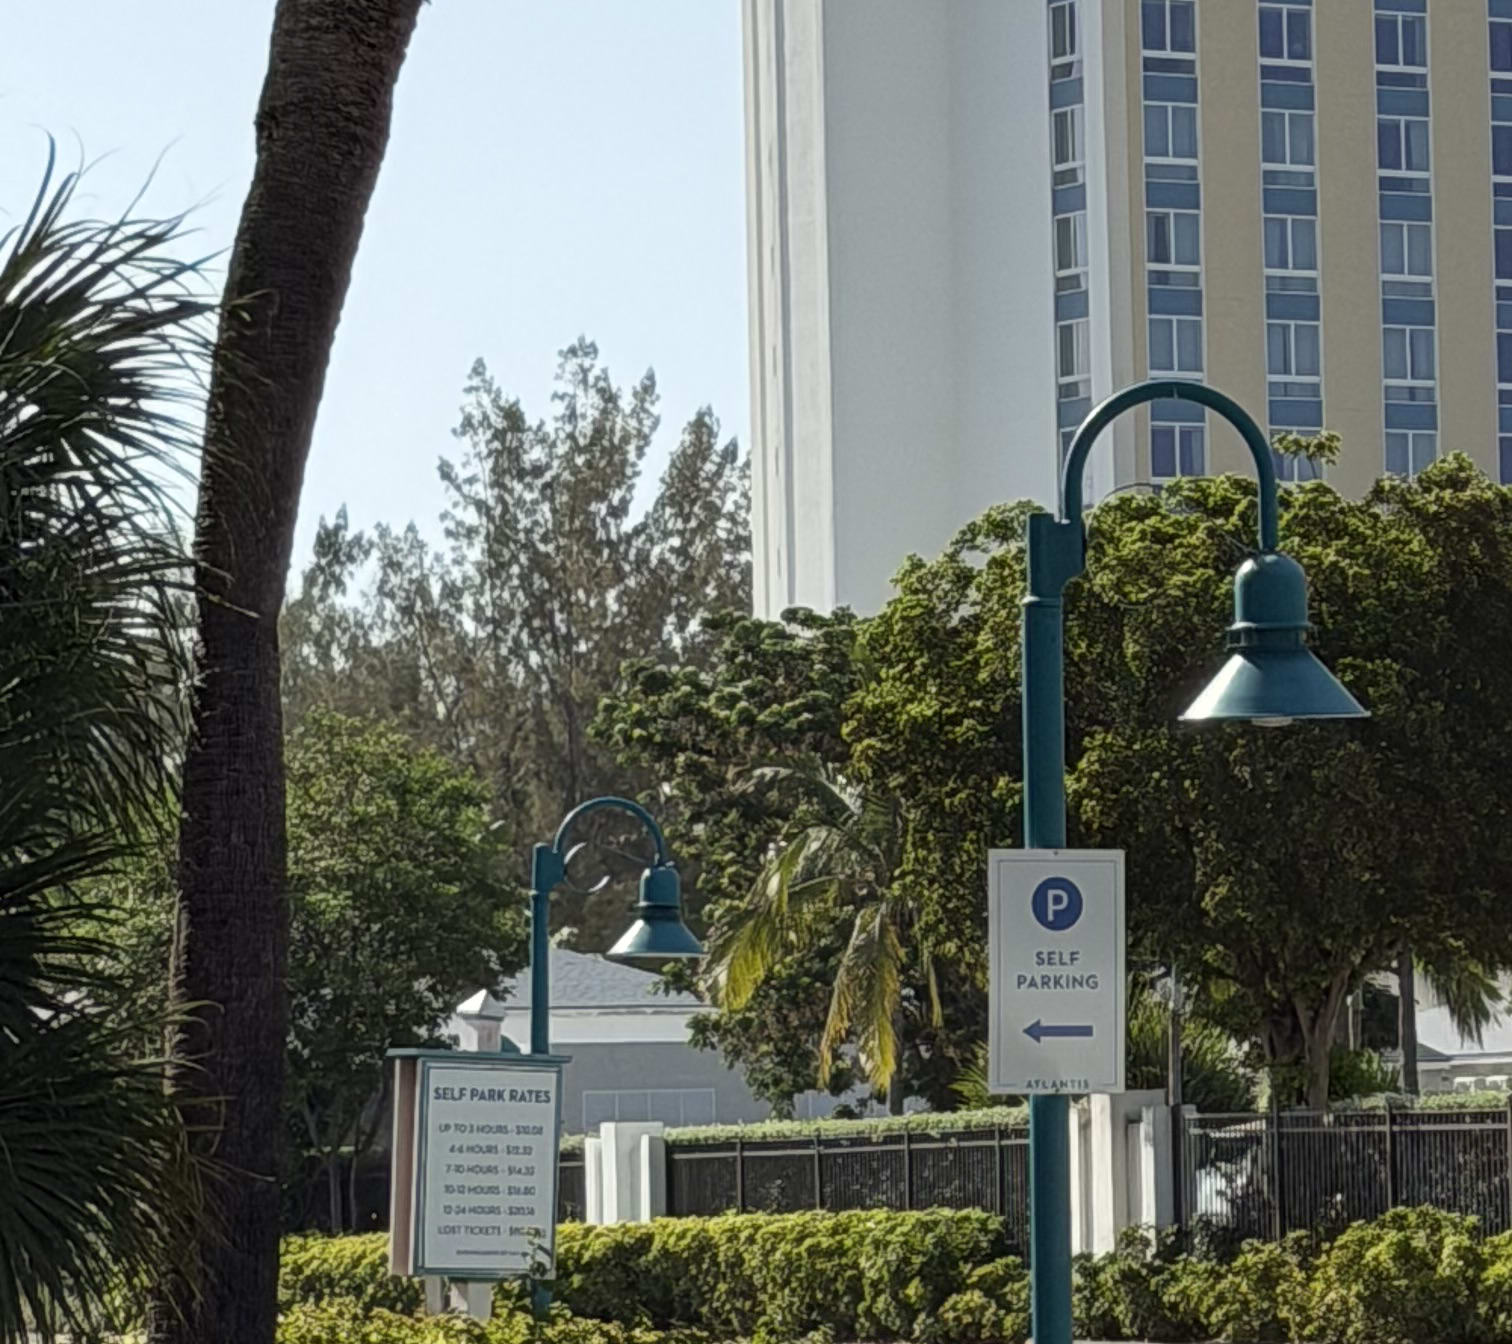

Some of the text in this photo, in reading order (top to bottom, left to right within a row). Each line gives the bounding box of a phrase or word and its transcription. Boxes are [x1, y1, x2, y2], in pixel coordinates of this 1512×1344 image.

[1047, 889, 1069, 921] P
[1035, 951, 1080, 966] SELF
[1017, 974, 1099, 990] PARKING
[1026, 1079, 1089, 1090] ATLANTIS
[434, 1087, 551, 1103] SELF PARK RATES
[439, 1123, 451, 1133] UP
[454, 1123, 467, 1134] TO
[477, 1124, 508, 1135] HOURS
[466, 1144, 498, 1155] HOURS
[467, 1164, 499, 1175] HOURS
[468, 1185, 500, 1195] HOURS
[468, 1205, 501, 1215] HOURS
[438, 1225, 462, 1235] LOST
[464, 1225, 501, 1235] TICKETS
